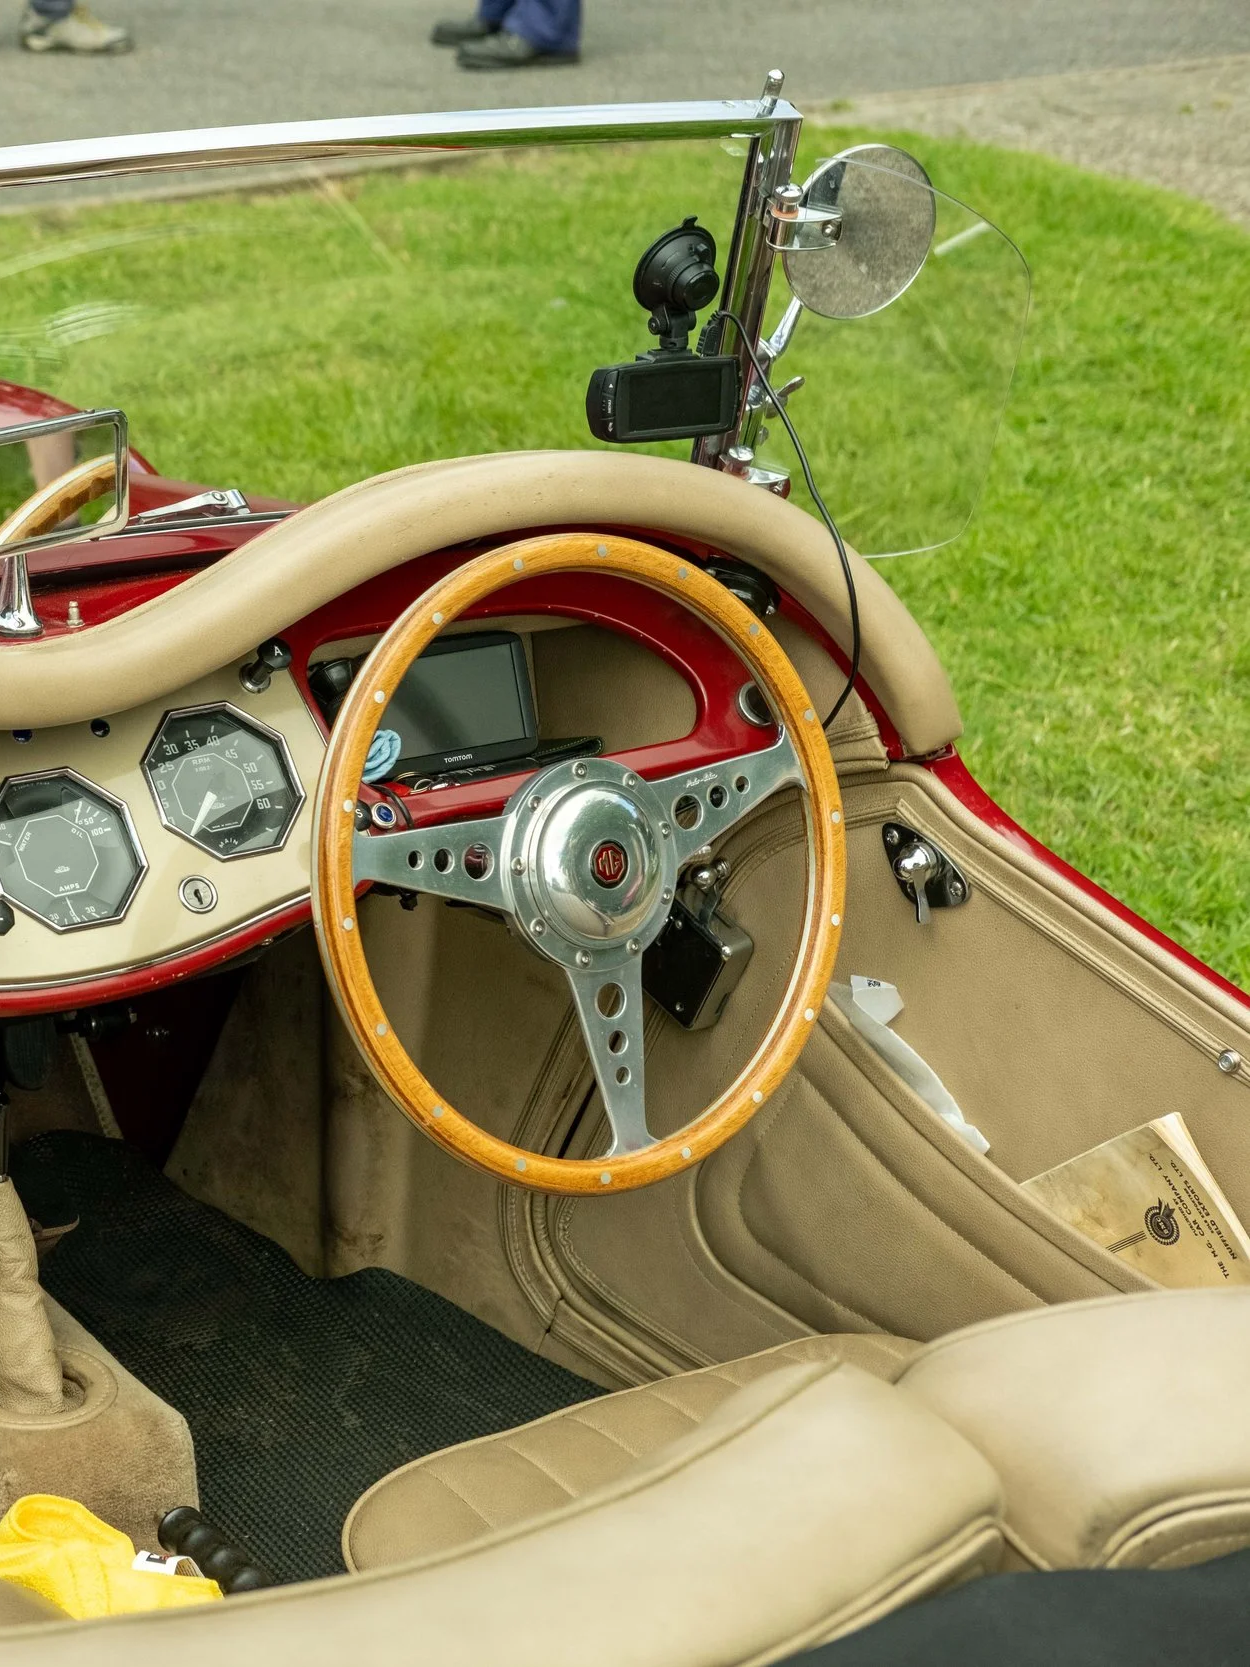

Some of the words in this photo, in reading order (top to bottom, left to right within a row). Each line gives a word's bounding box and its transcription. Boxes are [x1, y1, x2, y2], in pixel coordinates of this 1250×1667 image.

[274, 645, 283, 656] A
[184, 740, 199, 751] 35
[206, 735, 220, 746] 40
[163, 743, 178, 756] 30
[224, 748, 238, 759] 45
[158, 762, 175, 774] 25
[243, 762, 258, 774] 50
[250, 780, 264, 791] 55
[256, 798, 271, 810] 60
[355, 808, 364, 818] S
[84, 817, 94, 826] 50
[71, 828, 84, 839] OIL
[91, 827, 104, 837] 100
[18, 832, 32, 852] WATER
[218, 837, 239, 848] MAIN
[598, 850, 622, 876] MG
[59, 882, 80, 892] AMPS
[85, 906, 96, 914] 30
[1150, 1153, 1163, 1171] LTD.
[1170, 1159, 1184, 1178] LTD.
[1163, 1174, 1192, 1216] COMPANY
[1184, 1180, 1211, 1217] EXPORTS
[1192, 1218, 1205, 1237] CAR
[1210, 1220, 1238, 1260] NUFFIELD
[1206, 1240, 1219, 1258] M.G.
[1218, 1261, 1230, 1280] THE
